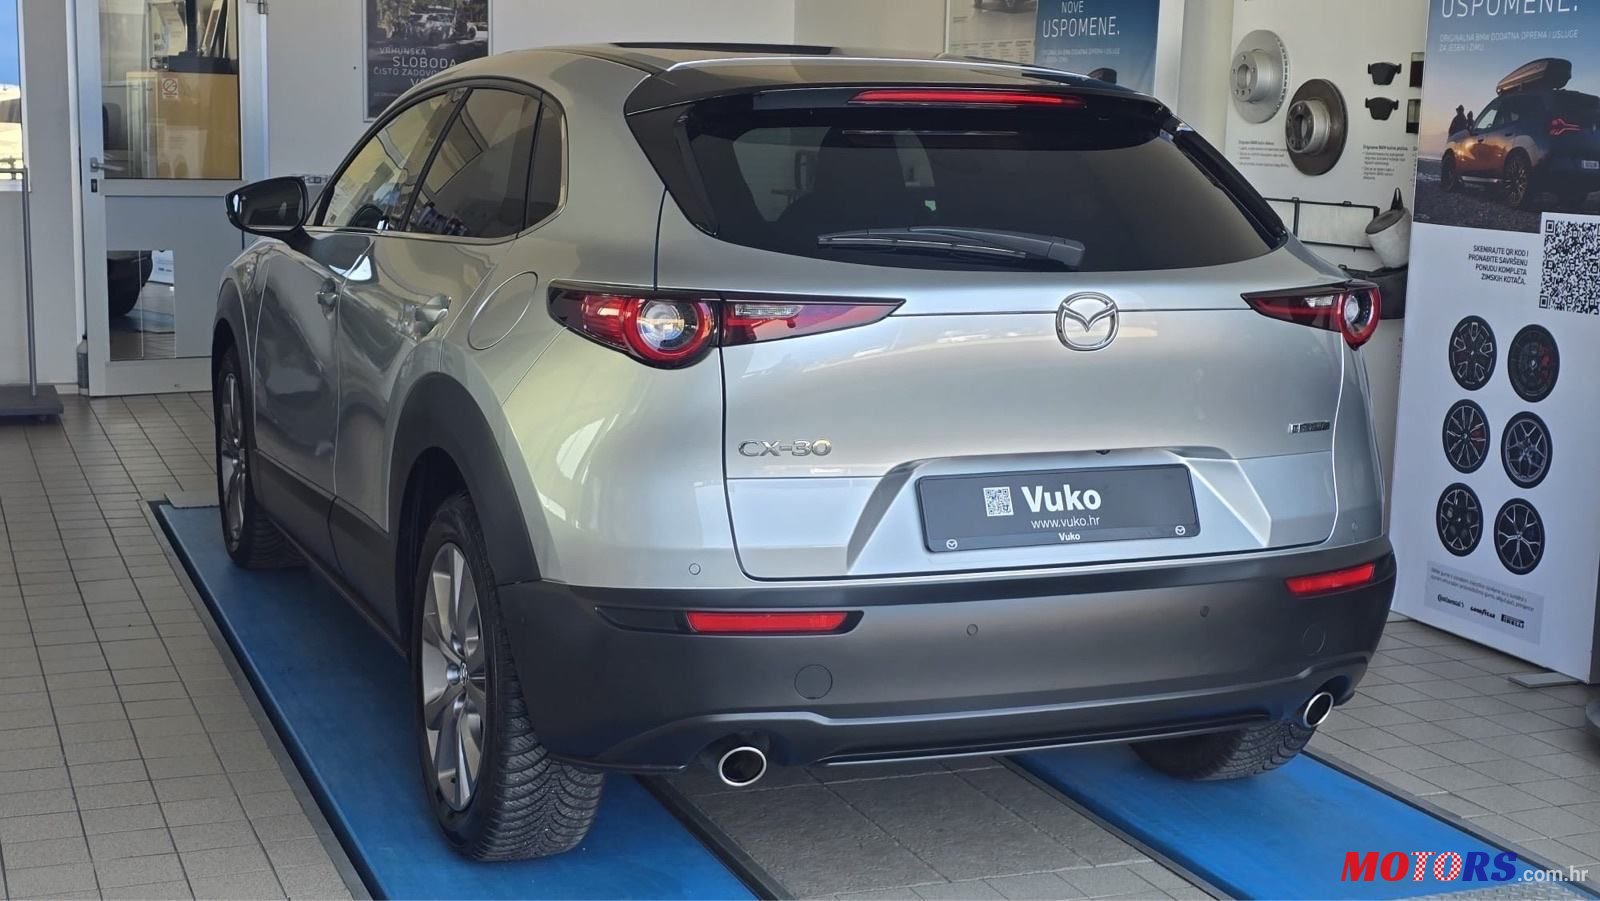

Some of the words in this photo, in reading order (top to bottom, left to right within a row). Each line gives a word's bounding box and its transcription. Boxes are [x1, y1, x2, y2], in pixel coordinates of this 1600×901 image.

[1061, 0, 1084, 14] NOVE
[1042, 16, 1120, 38] USPOMENE.
[379, 47, 427, 56] VRHUNSKA
[393, 56, 457, 69] SLOBODA
[373, 66, 399, 76] ČISTO
[1473, 244, 1505, 255] SKENIRAJTE
[1499, 256, 1528, 266] SAVRŠENU
[1475, 263, 1498, 272] PONUDU
[1498, 266, 1527, 275] KOMPLETA
[1481, 273, 1502, 282] ZIMSKIH
[738, 440, 832, 457] CX-30
[1021, 484, 1102, 513] Vuko
[1031, 515, 1100, 529] www.vuko.hr
[1058, 531, 1081, 541] Vuko
